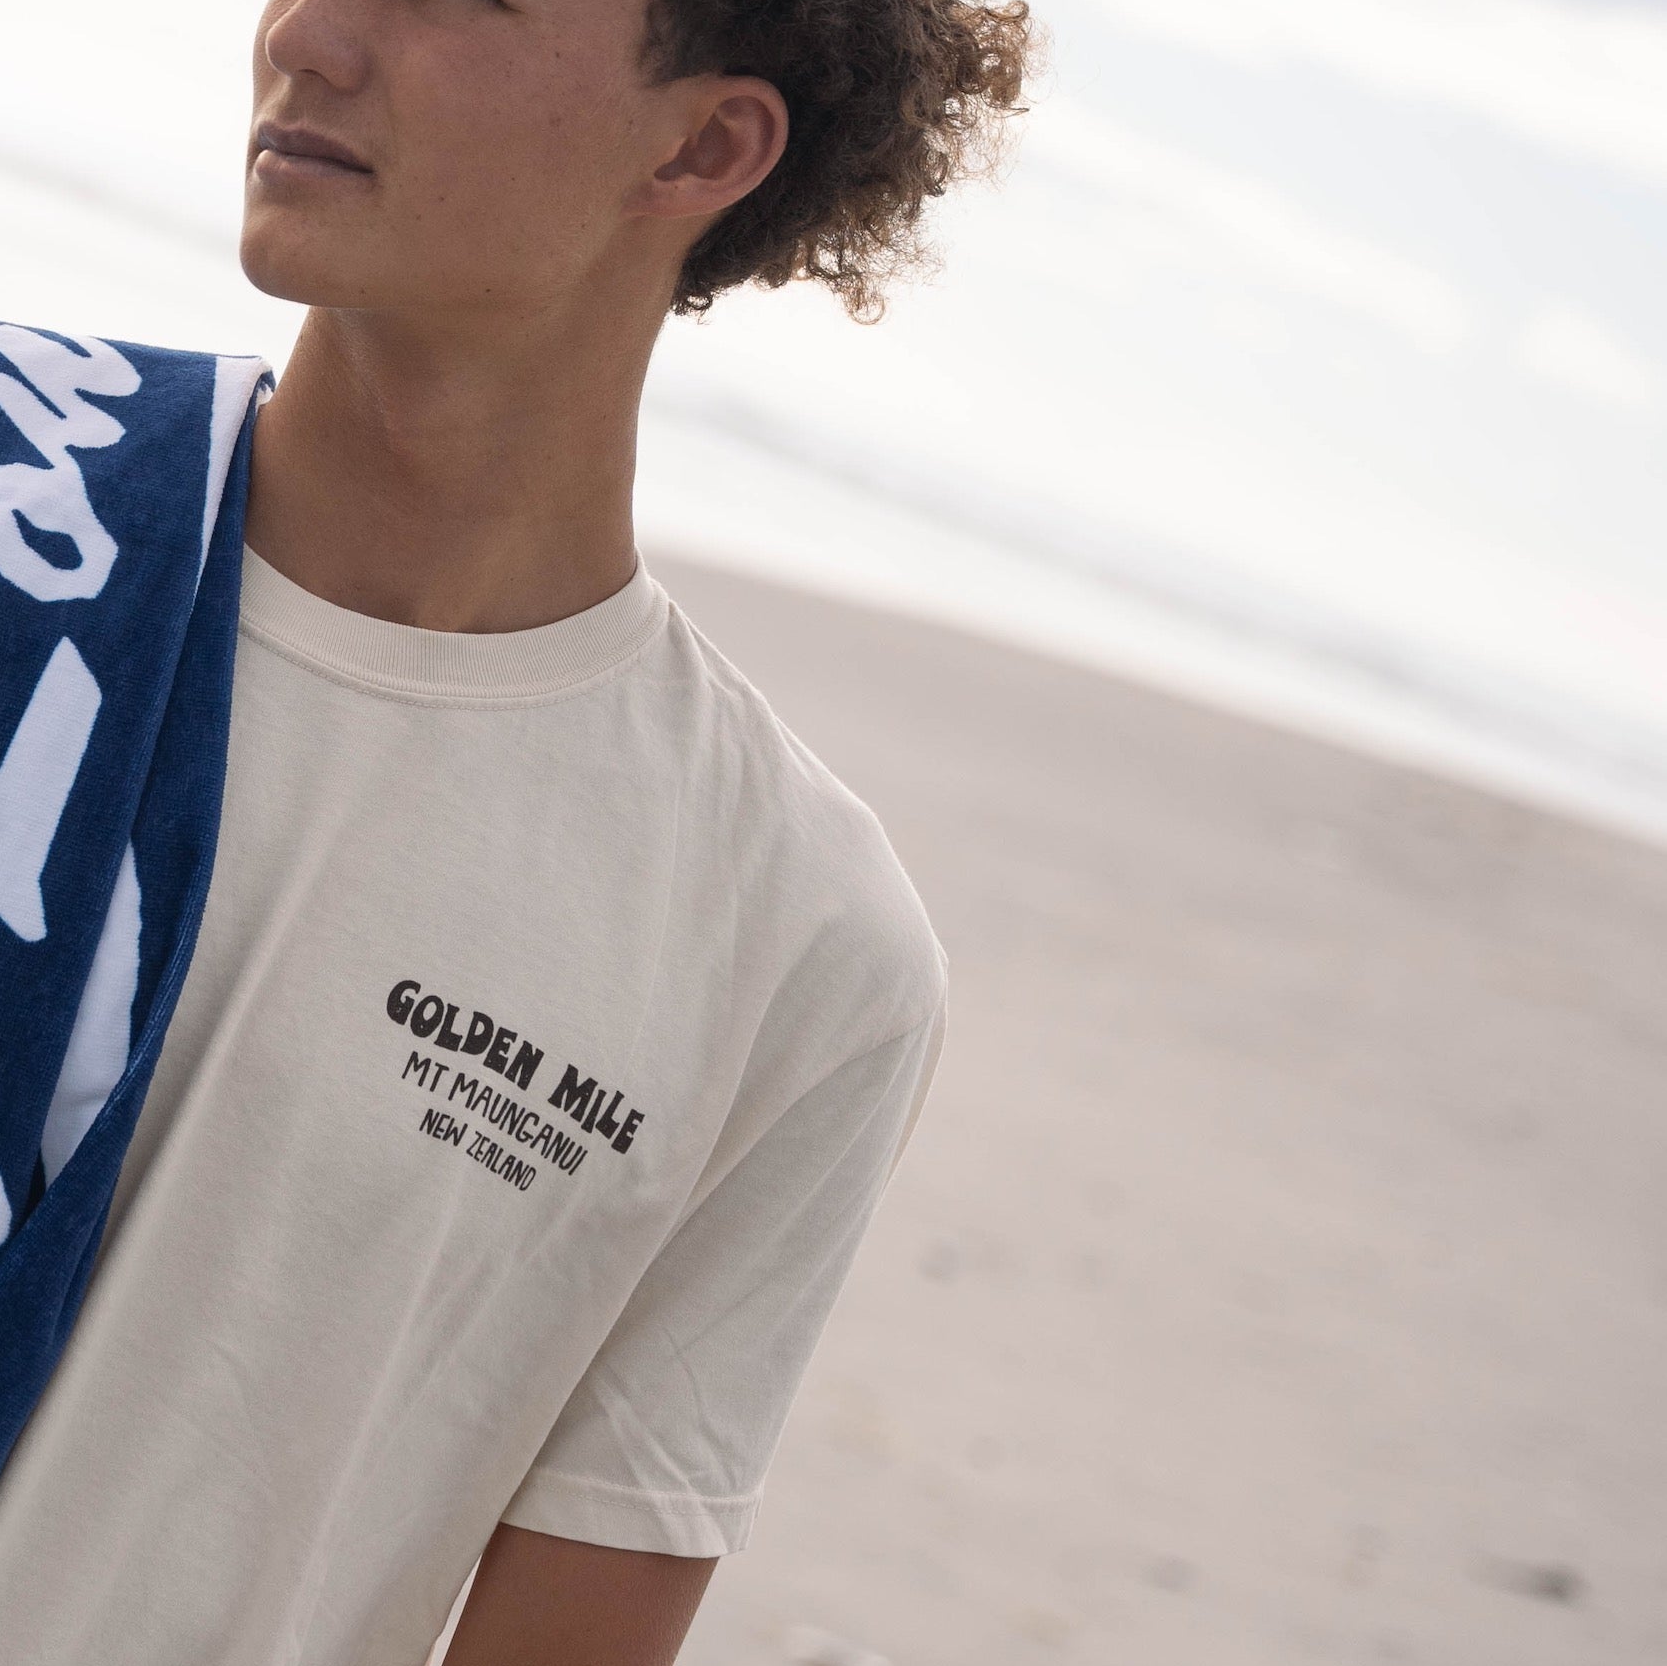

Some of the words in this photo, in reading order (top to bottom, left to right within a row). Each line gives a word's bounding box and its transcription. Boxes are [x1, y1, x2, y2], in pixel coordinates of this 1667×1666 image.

[386, 979, 545, 1091] GOLDEN
[547, 1063, 646, 1155] MILE
[401, 1050, 450, 1093] MT
[447, 1072, 589, 1176] MAUNGANUI
[418, 1108, 469, 1147] NEW
[465, 1130, 538, 1192] ZEALAND
